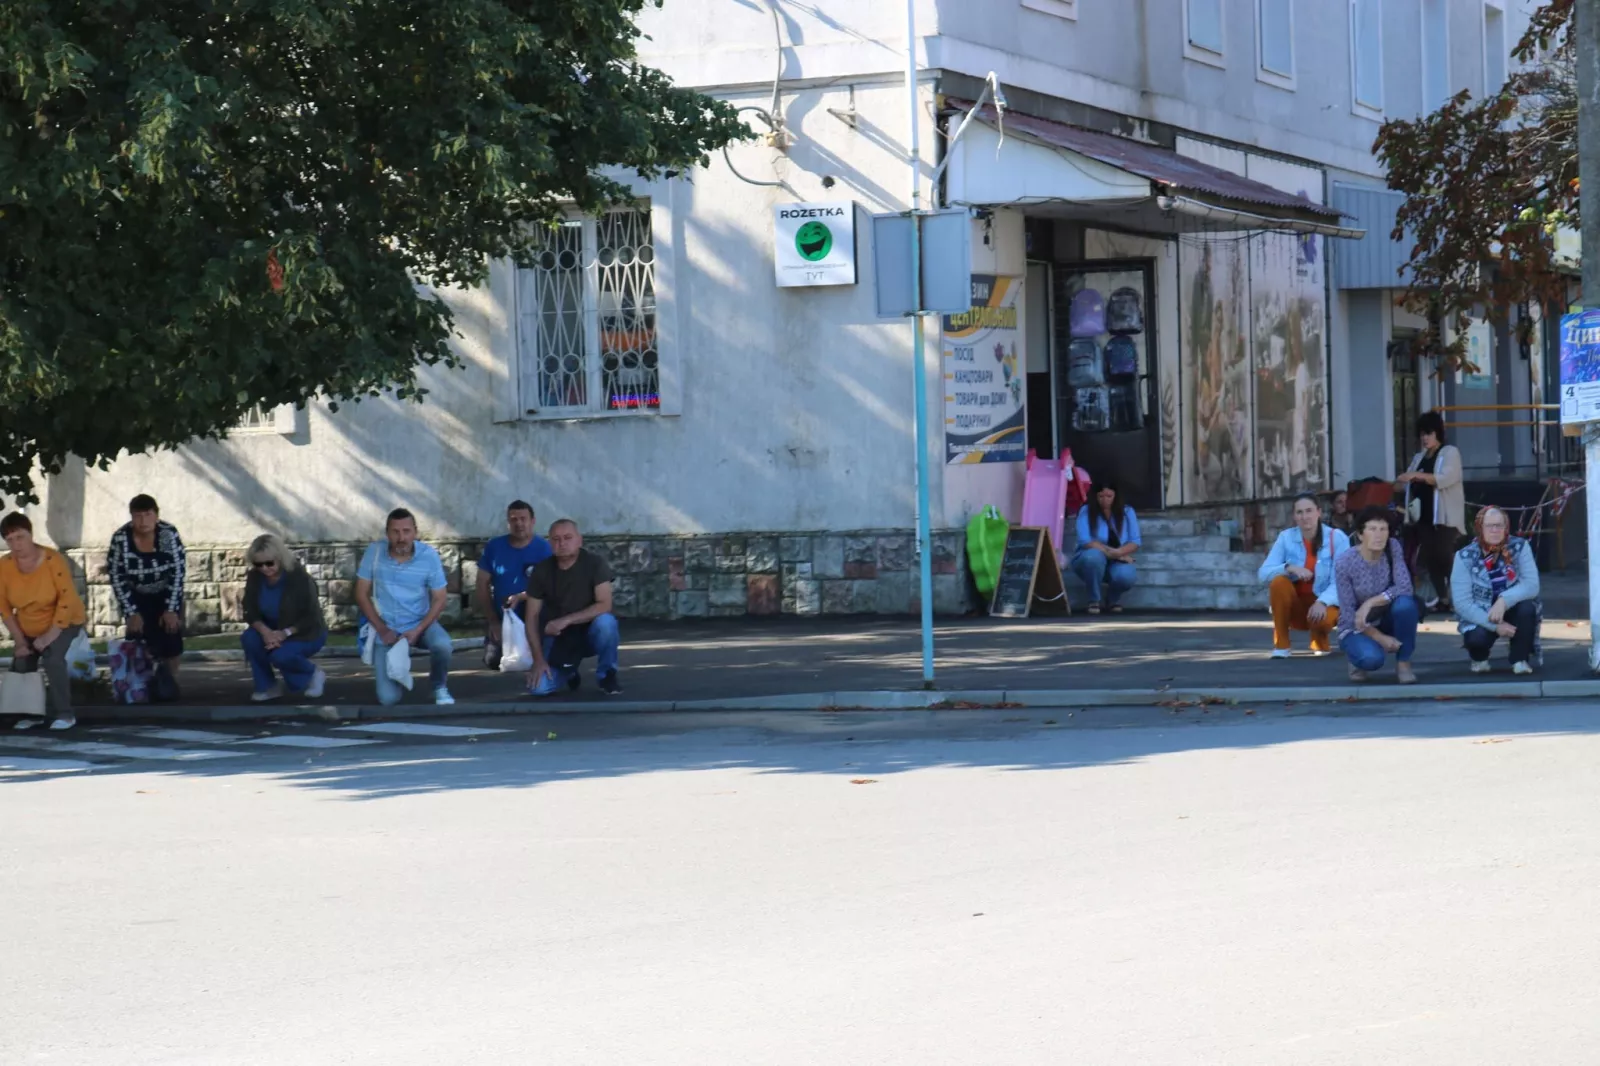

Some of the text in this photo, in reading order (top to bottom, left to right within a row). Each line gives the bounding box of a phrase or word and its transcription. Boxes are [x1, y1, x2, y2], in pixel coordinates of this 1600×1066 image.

[780, 207, 845, 219] ROZETKA
[806, 271, 825, 281] ТУТ
[972, 282, 989, 299] ЗИН
[955, 370, 993, 385] КАНЦТОВАРИ
[1566, 386, 1575, 397] 4
[955, 392, 978, 406] ТОВАРИ
[956, 414, 991, 429] ПОДАРУНКИ
